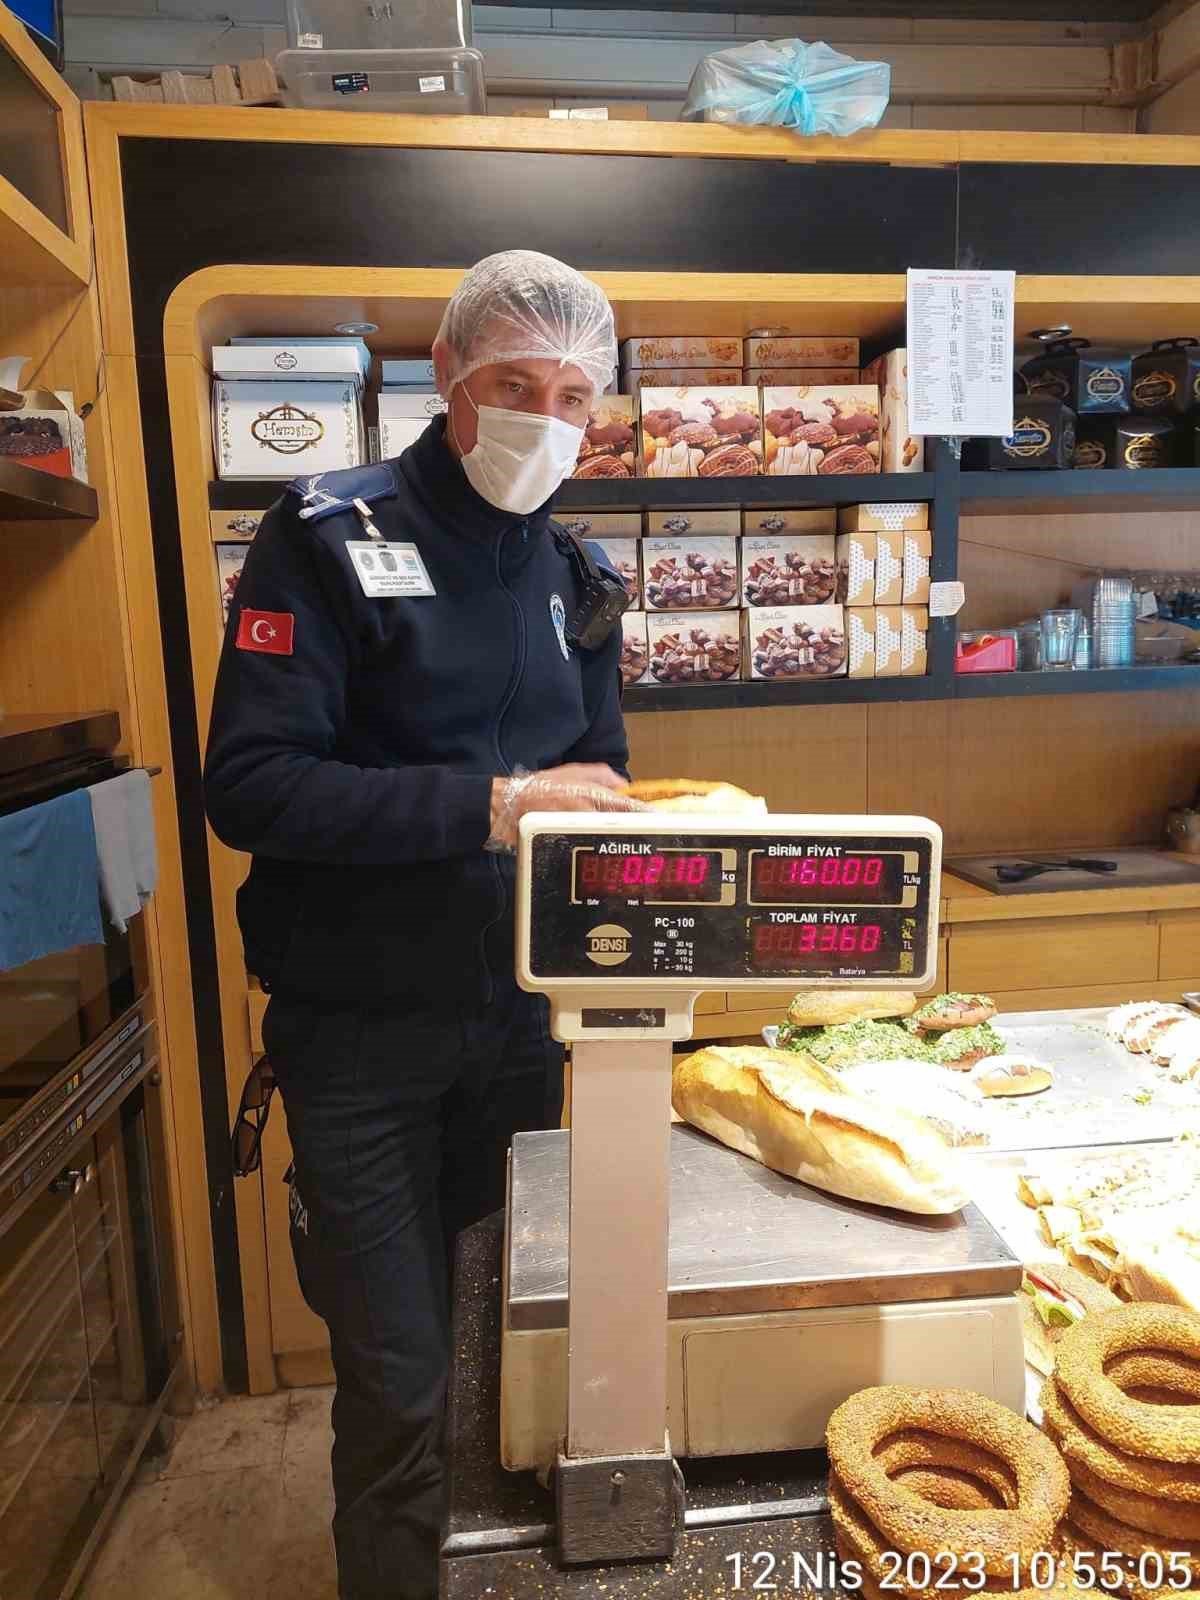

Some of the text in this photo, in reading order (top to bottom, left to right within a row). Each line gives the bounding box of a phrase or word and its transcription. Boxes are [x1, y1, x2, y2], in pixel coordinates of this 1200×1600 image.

[598, 841, 652, 854] AĞIRLIK
[768, 844, 842, 857] BİRİM FİYAT
[721, 872, 736, 882] kg
[790, 858, 884, 886] 160.00
[654, 917, 695, 928] PC-100
[769, 911, 858, 924] TOPLAM FİYAT
[654, 940, 667, 948] Max
[903, 940, 912, 950] TL
